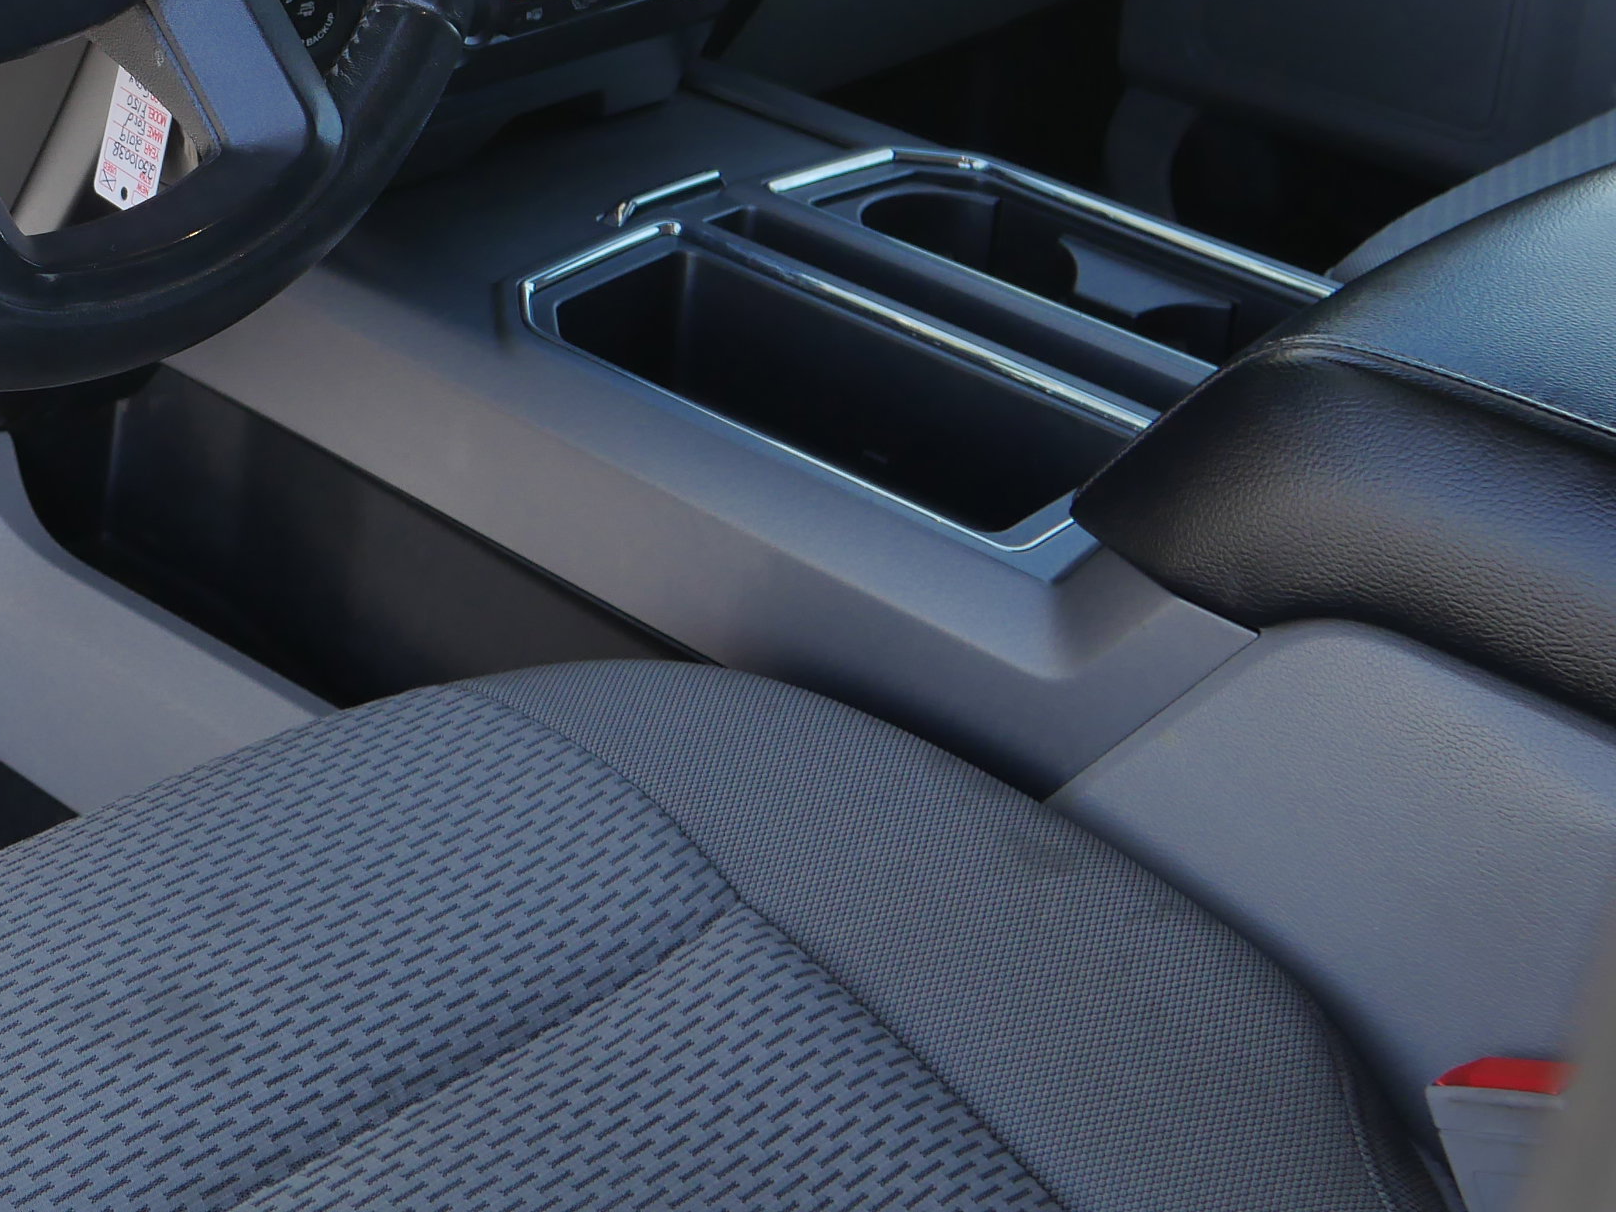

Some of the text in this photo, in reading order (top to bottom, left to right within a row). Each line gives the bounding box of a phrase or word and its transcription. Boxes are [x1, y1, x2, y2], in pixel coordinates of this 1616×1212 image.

[306, 12, 335, 47] BACKUP
[127, 94, 147, 119] F150
[147, 106, 168, 128] MODEL
[123, 112, 164, 144] MAKE Ford
[144, 142, 160, 162] YEAR
[136, 181, 149, 196] NEW
